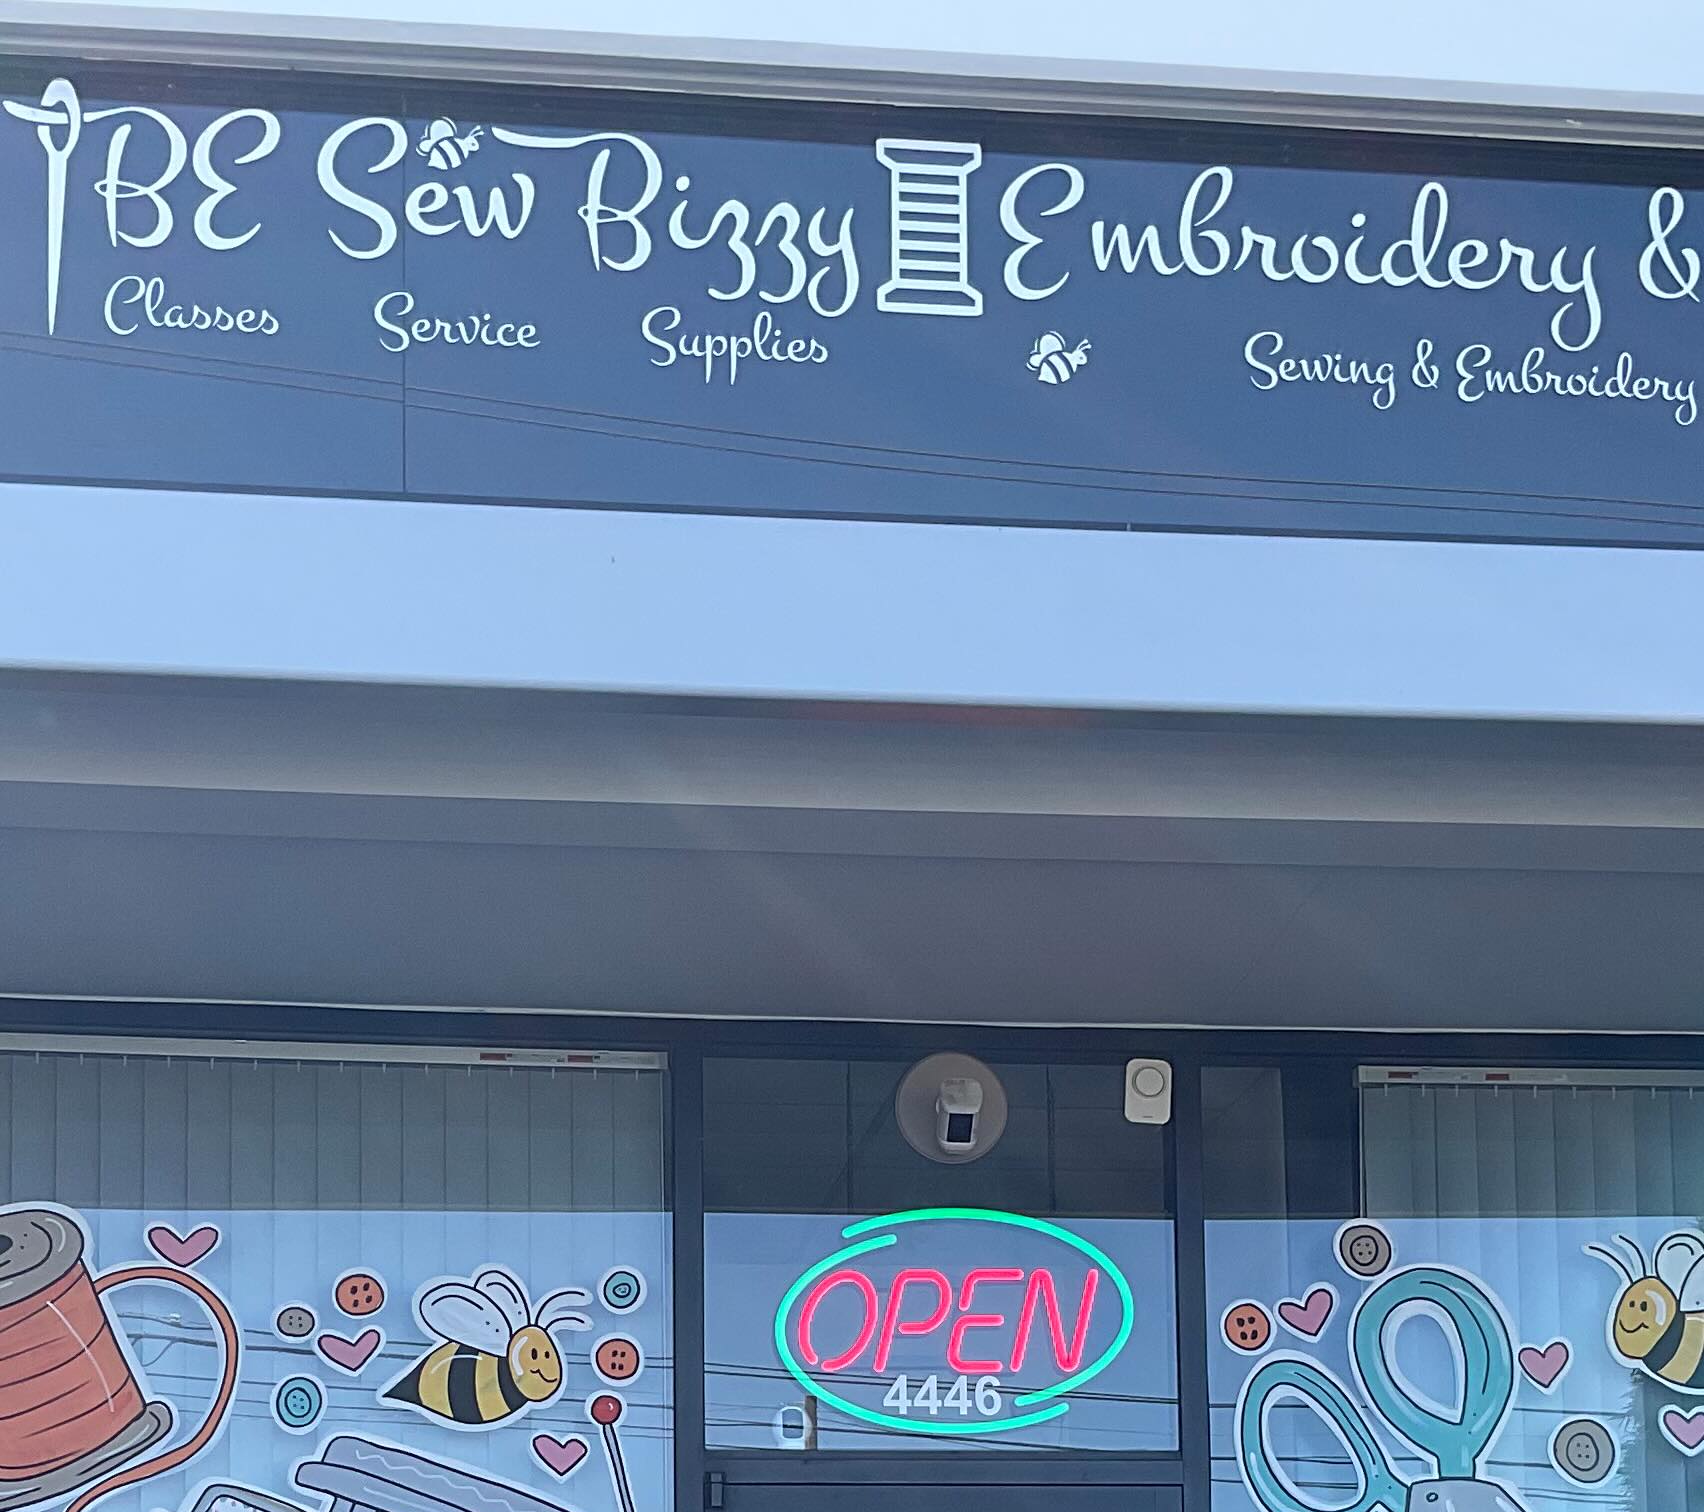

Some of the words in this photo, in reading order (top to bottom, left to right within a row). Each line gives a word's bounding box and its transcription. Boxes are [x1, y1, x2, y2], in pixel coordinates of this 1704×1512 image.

[84, 105, 281, 251] BE
[318, 117, 535, 260] Sew
[491, 126, 860, 317] Bizzy
[1000, 163, 1602, 352] Embroidery
[1639, 186, 1701, 303] &
[104, 275, 280, 336] Classes
[374, 291, 541, 352] Service
[642, 306, 829, 385] Supplies
[1245, 331, 1395, 410] Sewing
[1411, 338, 1440, 389] &
[1456, 344, 1698, 426] Embroidery
[798, 1268, 1099, 1374] OPEN
[883, 1374, 1002, 1416] 4446
